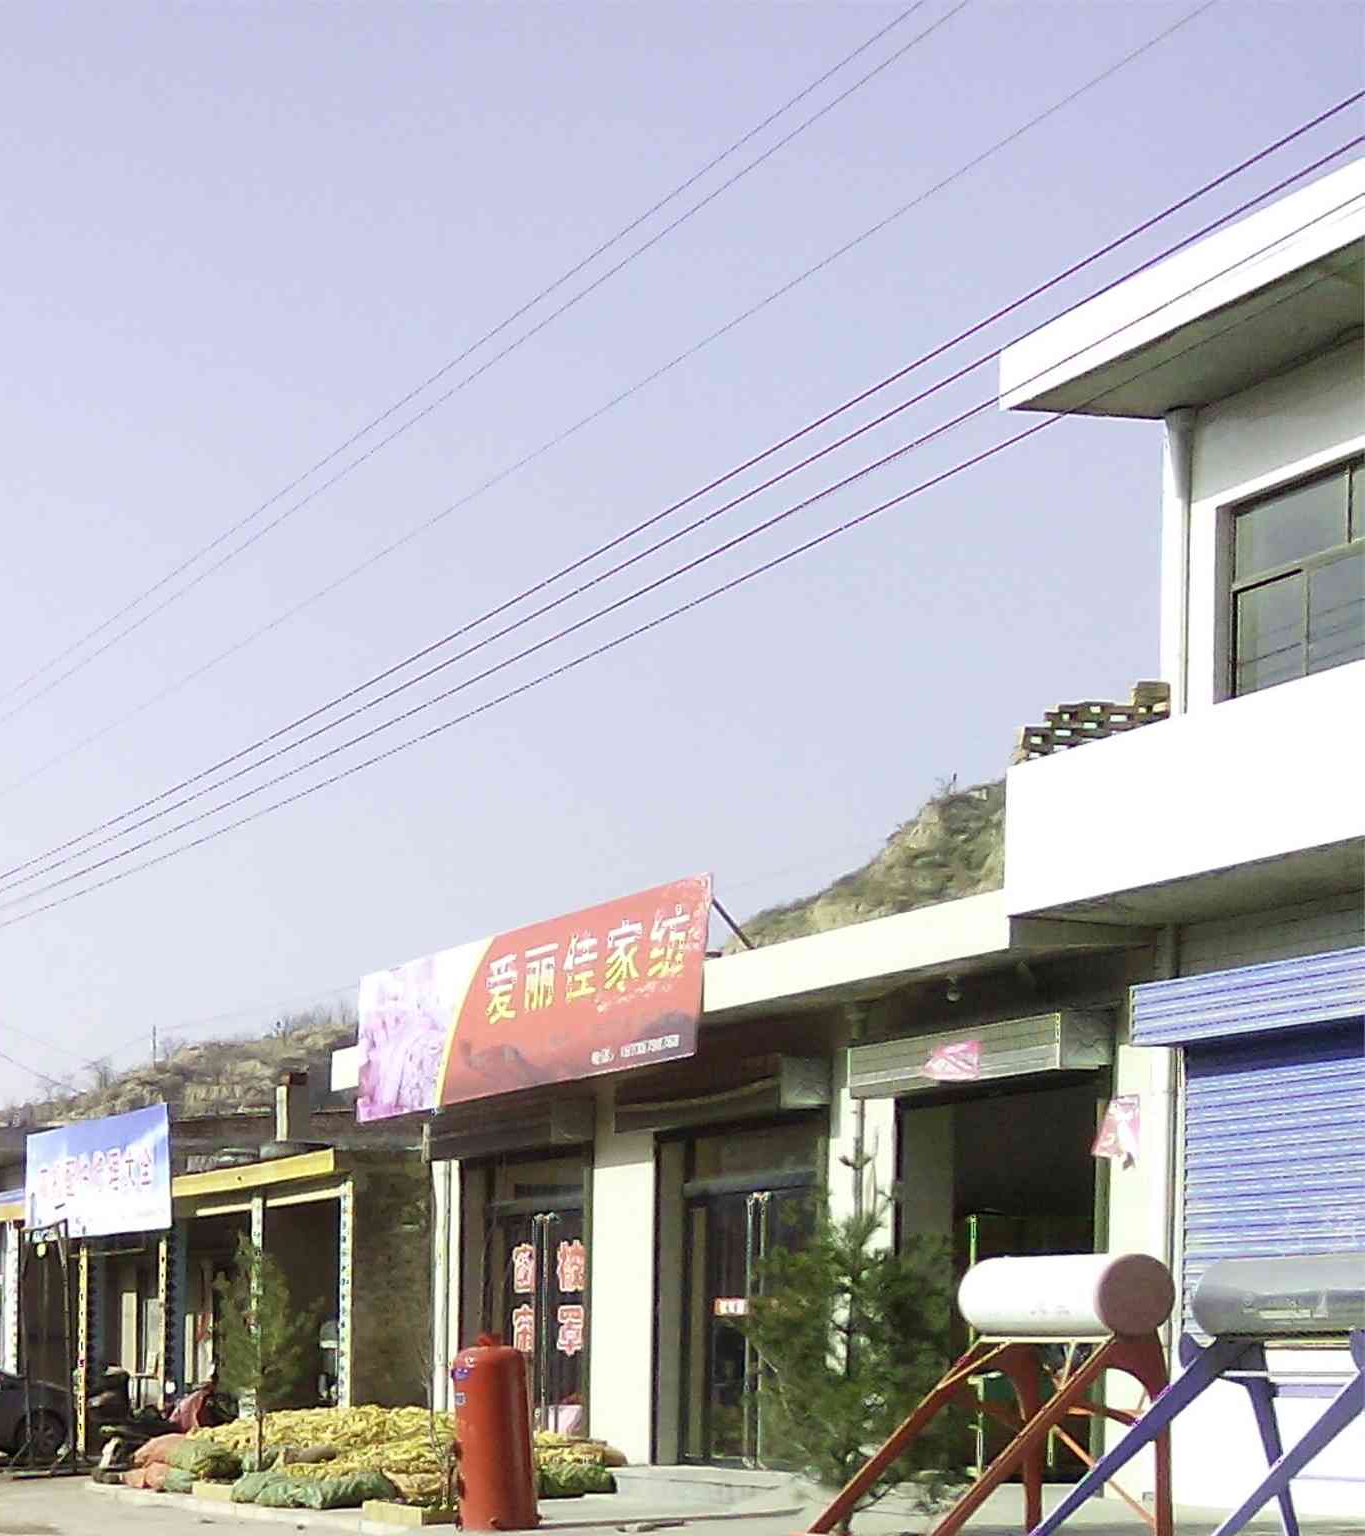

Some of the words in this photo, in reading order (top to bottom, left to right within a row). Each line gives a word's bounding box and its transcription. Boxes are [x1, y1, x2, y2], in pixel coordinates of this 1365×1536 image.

[485, 904, 691, 1024] 爱丽佳家纺
